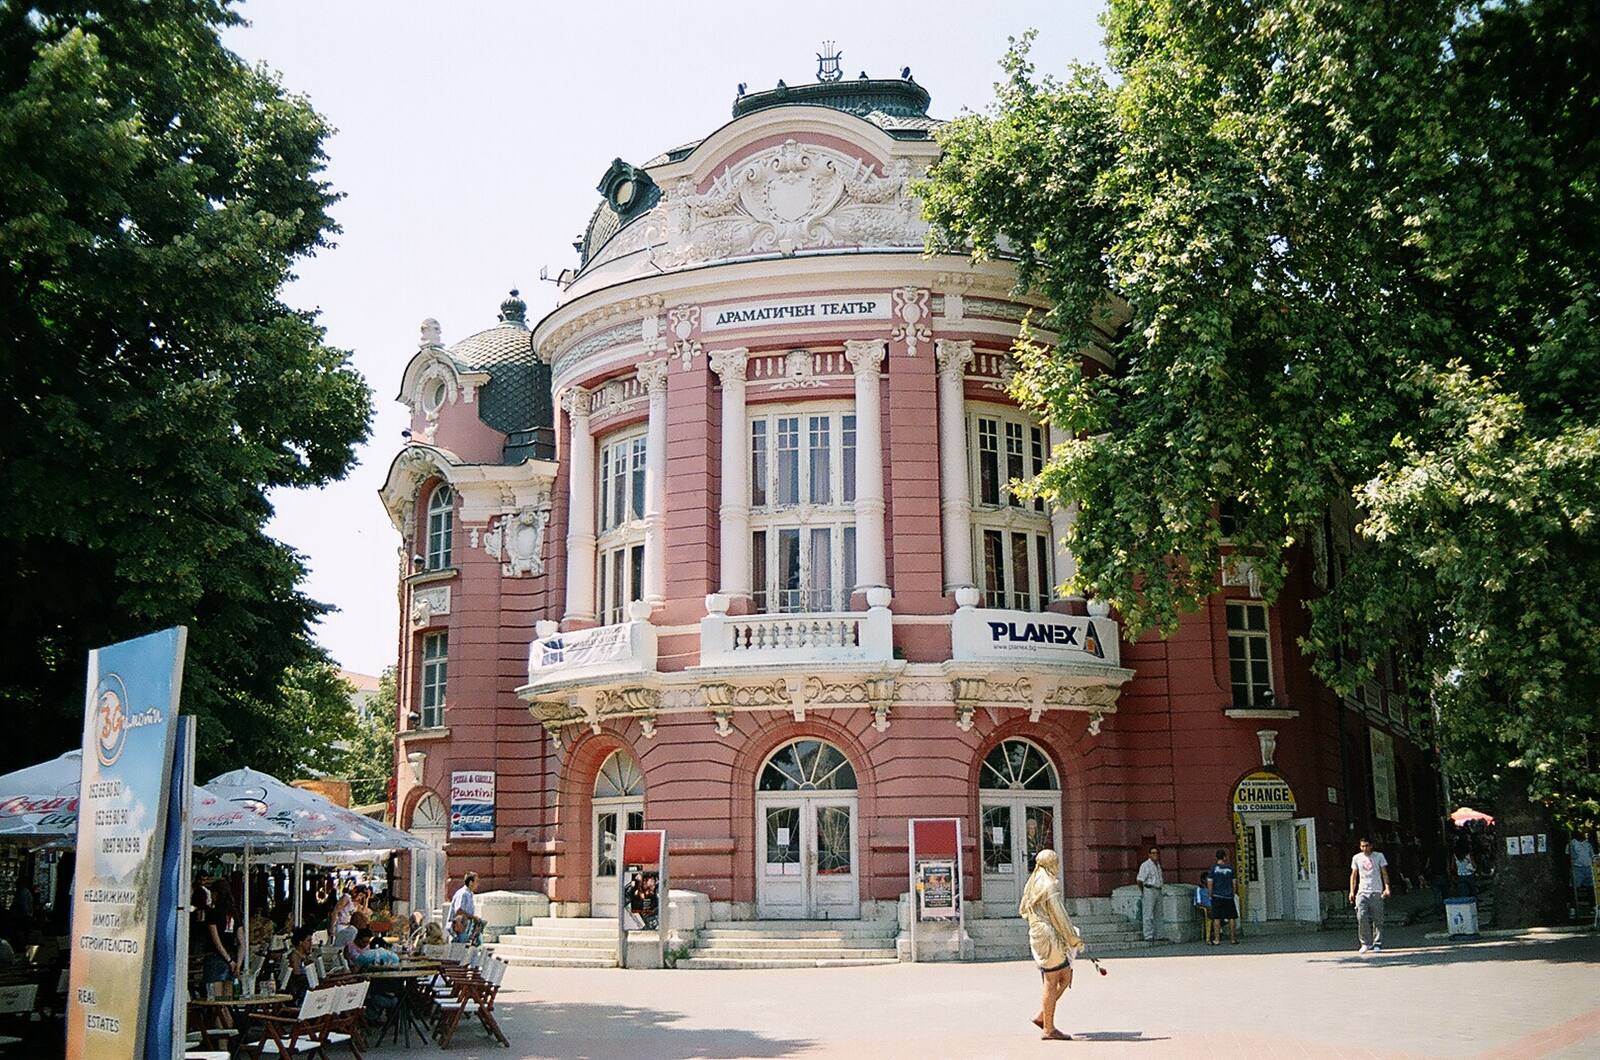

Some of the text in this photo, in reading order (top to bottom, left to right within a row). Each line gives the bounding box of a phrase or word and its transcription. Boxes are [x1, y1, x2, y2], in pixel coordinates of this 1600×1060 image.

[716, 302, 876, 325] ДРАМАТИЧЕН ТЕАТЪР
[987, 622, 1079, 645] PLANEX
[451, 787, 494, 799] Pantini
[1238, 788, 1290, 801] CHANGE
[459, 815, 492, 823] PEPSI
[83, 889, 136, 904] НЕДВИЖИМИ
[92, 913, 120, 927] ИМОТИ
[80, 935, 138, 954] СТРОИТЕЛСТВО
[78, 989, 96, 1005] REAL
[87, 1014, 120, 1033] ESTATES
